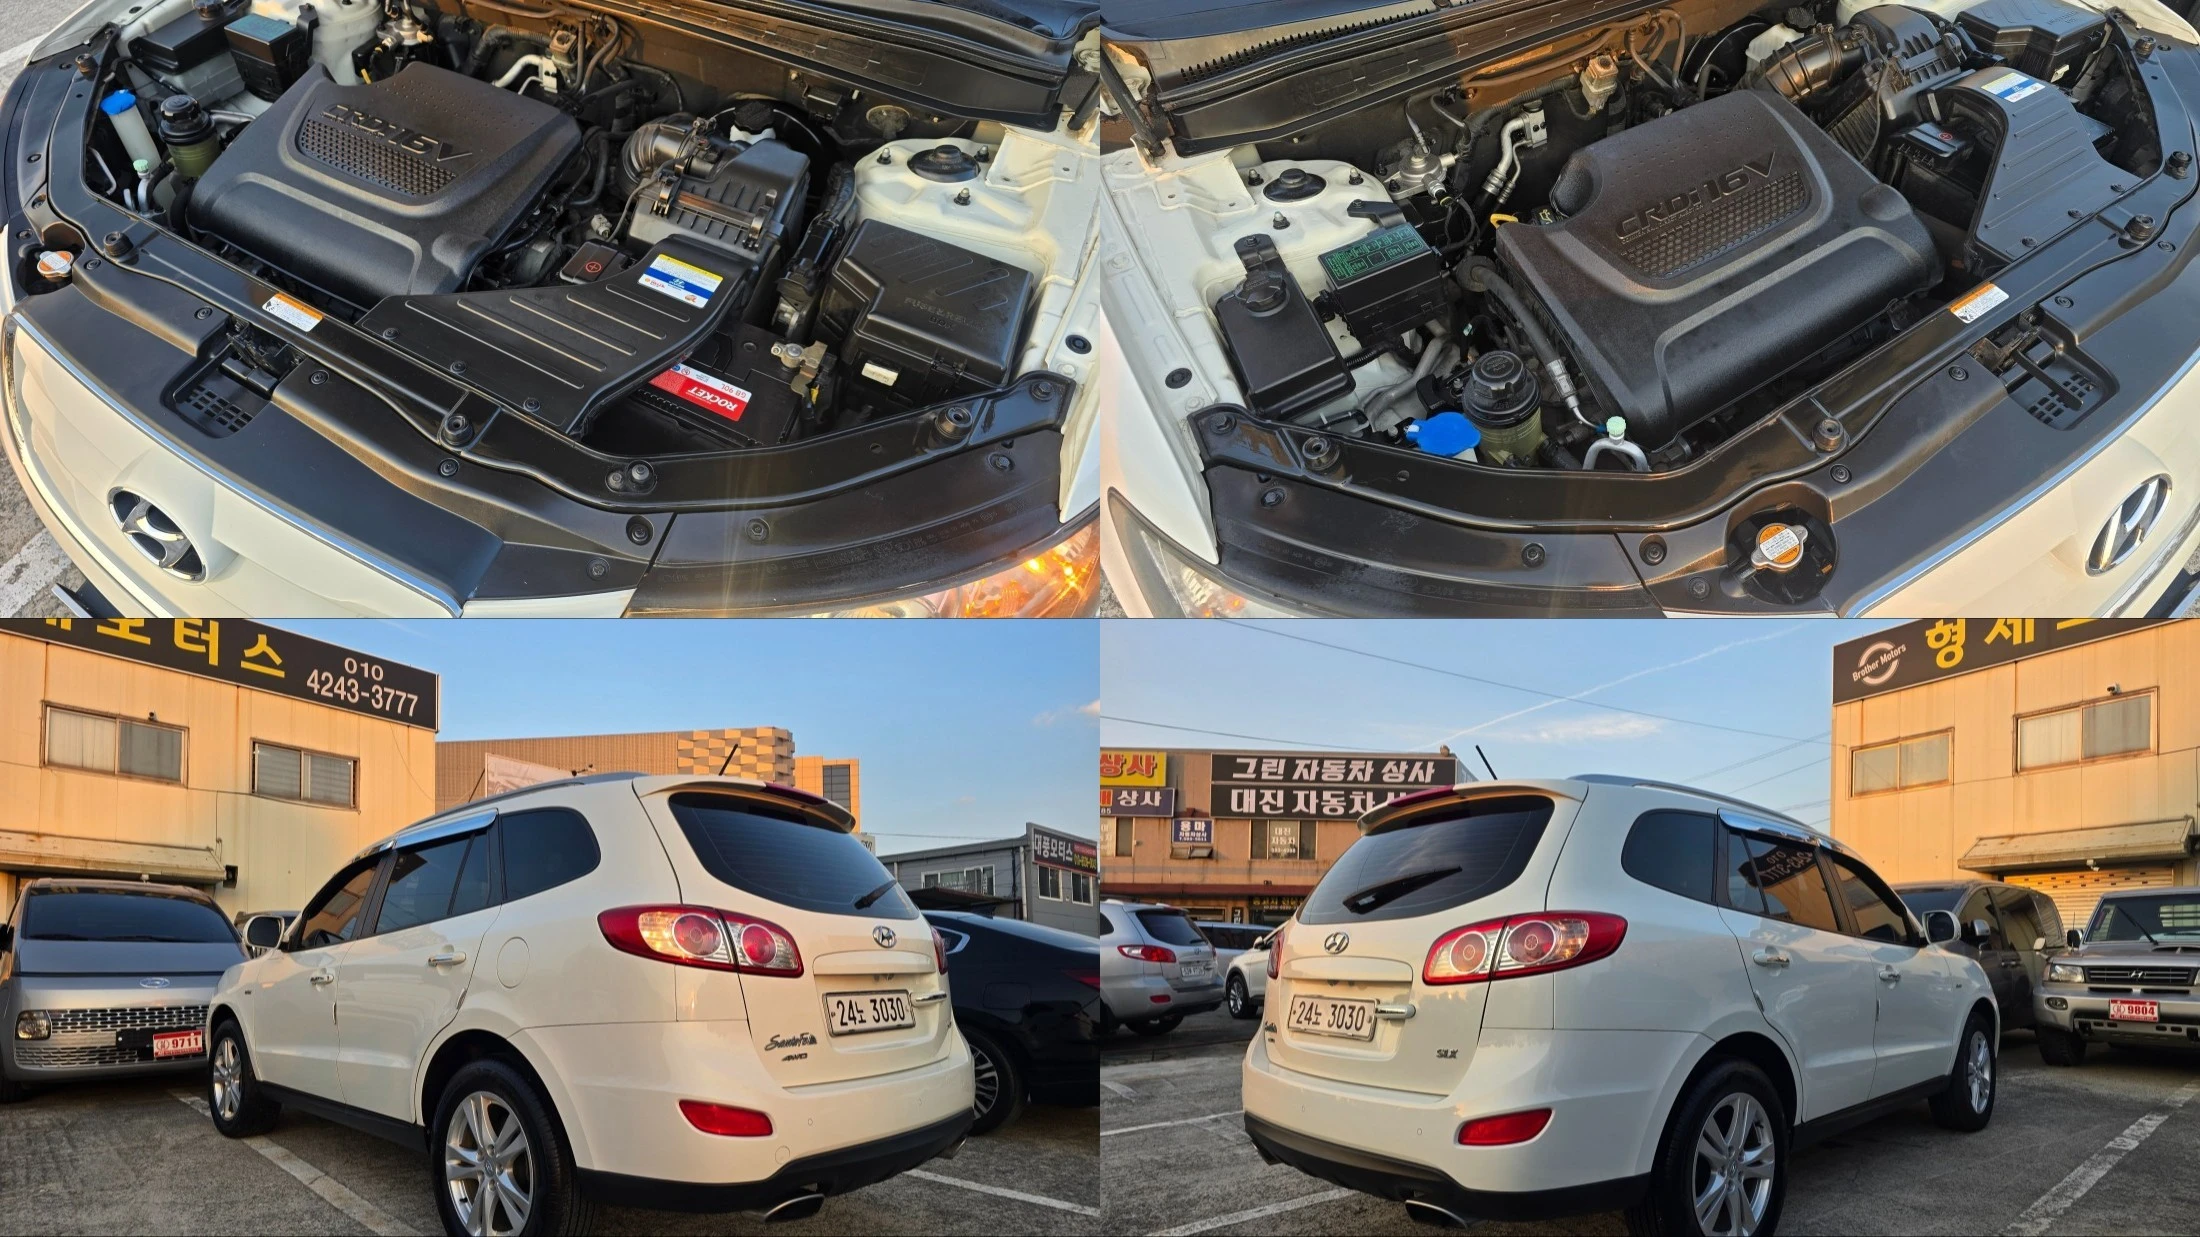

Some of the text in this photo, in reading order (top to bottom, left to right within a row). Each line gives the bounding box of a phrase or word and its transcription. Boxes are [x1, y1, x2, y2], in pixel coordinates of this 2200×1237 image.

[688, 386, 739, 412] ROCKET
[343, 657, 385, 682] 010
[1852, 643, 1907, 682] Brother Motors
[306, 668, 419, 718] 4243-3777
[1100, 753, 1157, 777] 상사
[1232, 758, 1436, 784] 그린 자동차 상사
[1117, 790, 1163, 807] 상사
[1230, 788, 1376, 816] 대진 자동차
[1034, 833, 1073, 862] 대풍모터스
[836, 997, 905, 1026] 24노 3030
[1296, 1001, 1366, 1032] 24노 3030
[2127, 1005, 2155, 1016] 9804
[172, 1037, 198, 1048] 9711
